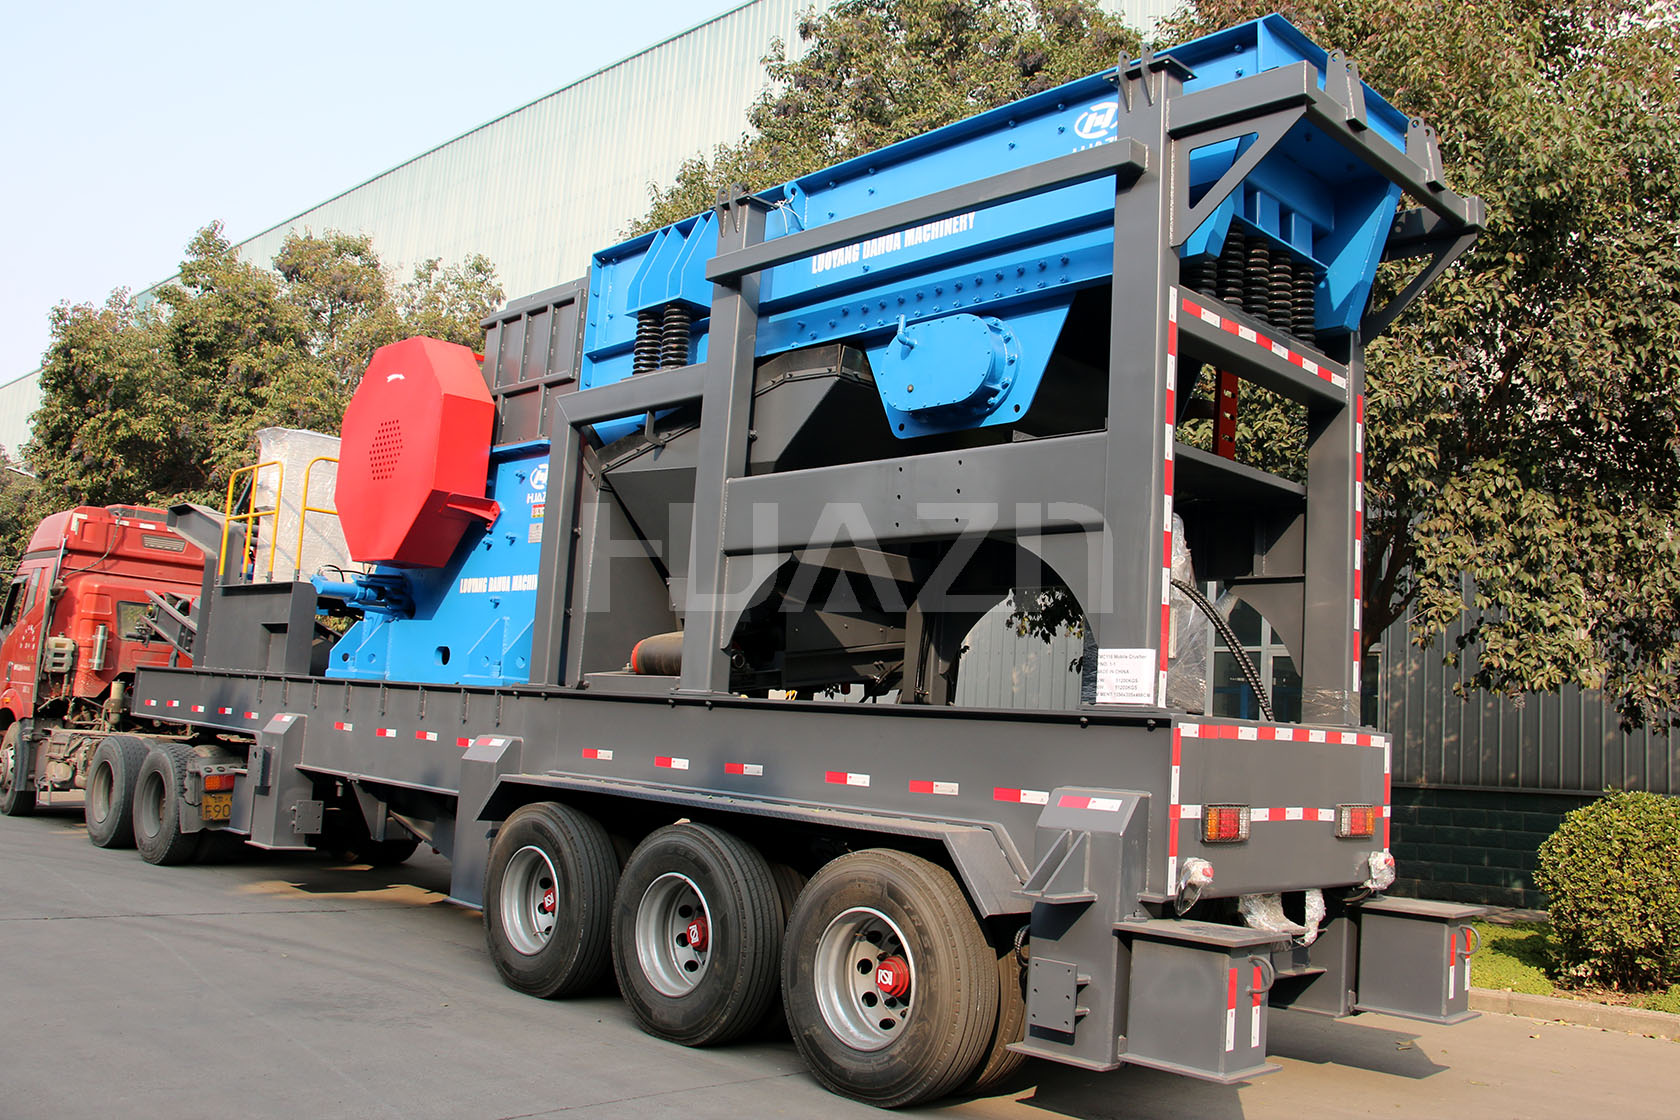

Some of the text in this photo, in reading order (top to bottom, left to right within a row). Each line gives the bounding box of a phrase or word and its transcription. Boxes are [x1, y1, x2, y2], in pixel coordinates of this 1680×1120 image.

[811, 211, 976, 274] LUOYANG DAHUA MACHINERY
[459, 577, 488, 593] LUOYANG
[488, 575, 511, 592] DAHUA
